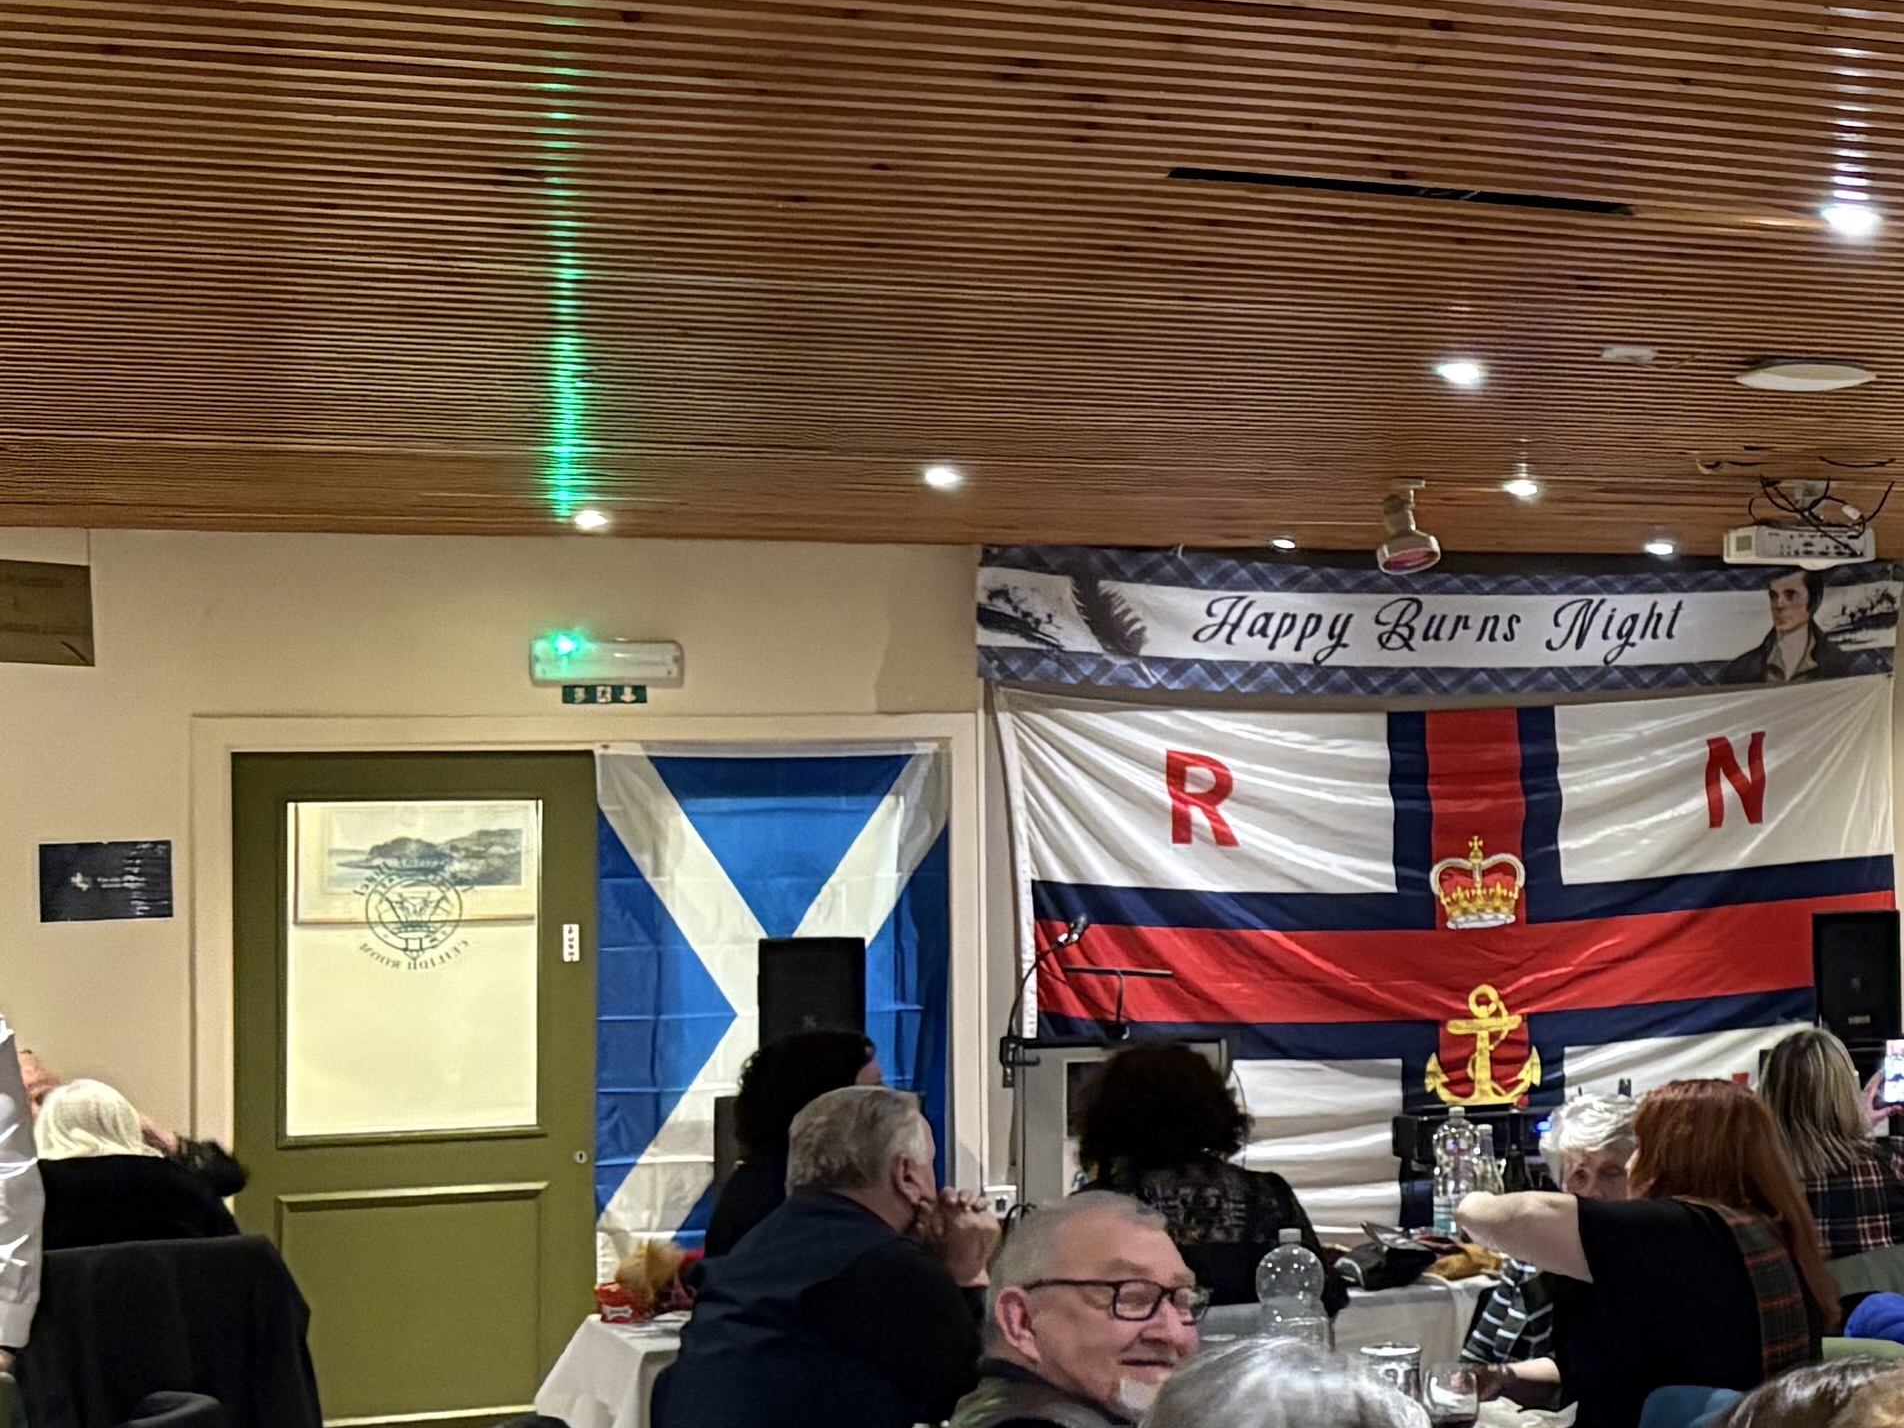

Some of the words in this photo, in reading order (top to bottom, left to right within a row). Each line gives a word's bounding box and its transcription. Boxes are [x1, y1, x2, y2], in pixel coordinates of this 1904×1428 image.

[1192, 595, 1355, 664] Happy
[1374, 597, 1522, 652] Burns
[1546, 597, 1685, 664] Night
[1164, 749, 1238, 848] R
[1705, 729, 1766, 829] N
